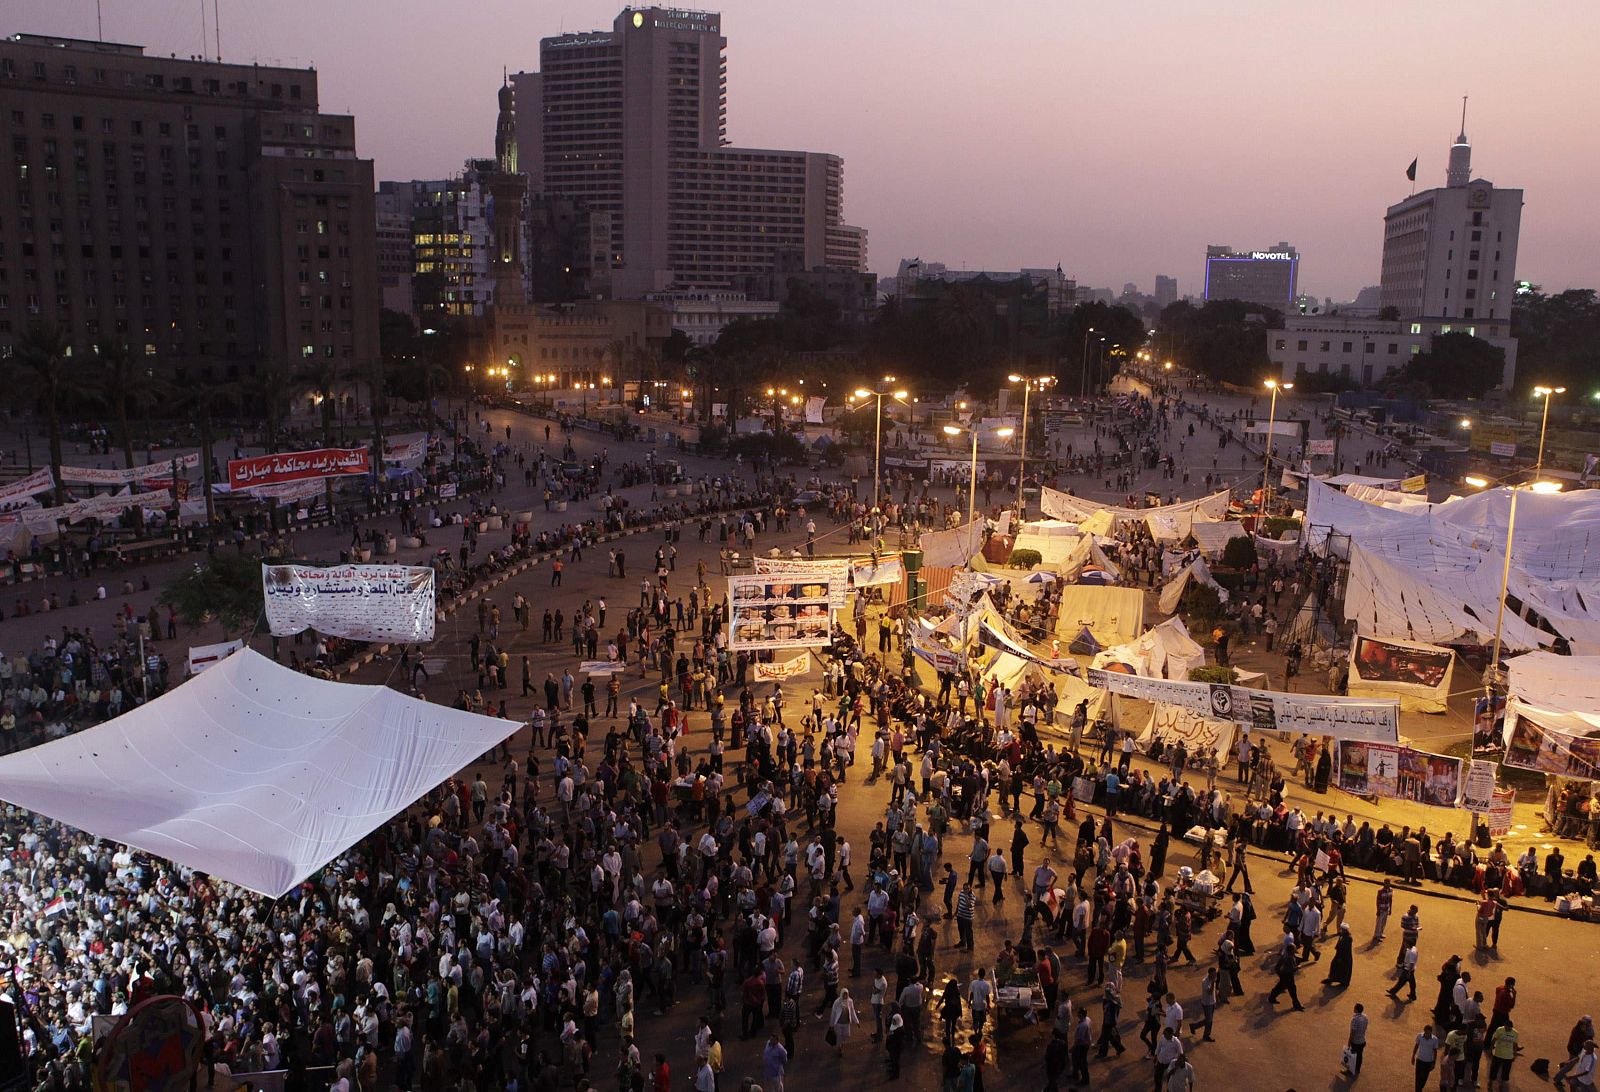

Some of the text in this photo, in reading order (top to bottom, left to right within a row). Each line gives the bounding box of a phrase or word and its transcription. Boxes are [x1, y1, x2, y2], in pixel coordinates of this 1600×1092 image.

[655, 20, 717, 32] INTERCONINENAL
[1252, 252, 1291, 260] NOVOTEL
[235, 452, 363, 481] الشعب يريد محاكمة مبارك
[1377, 710, 1391, 732] وقف
